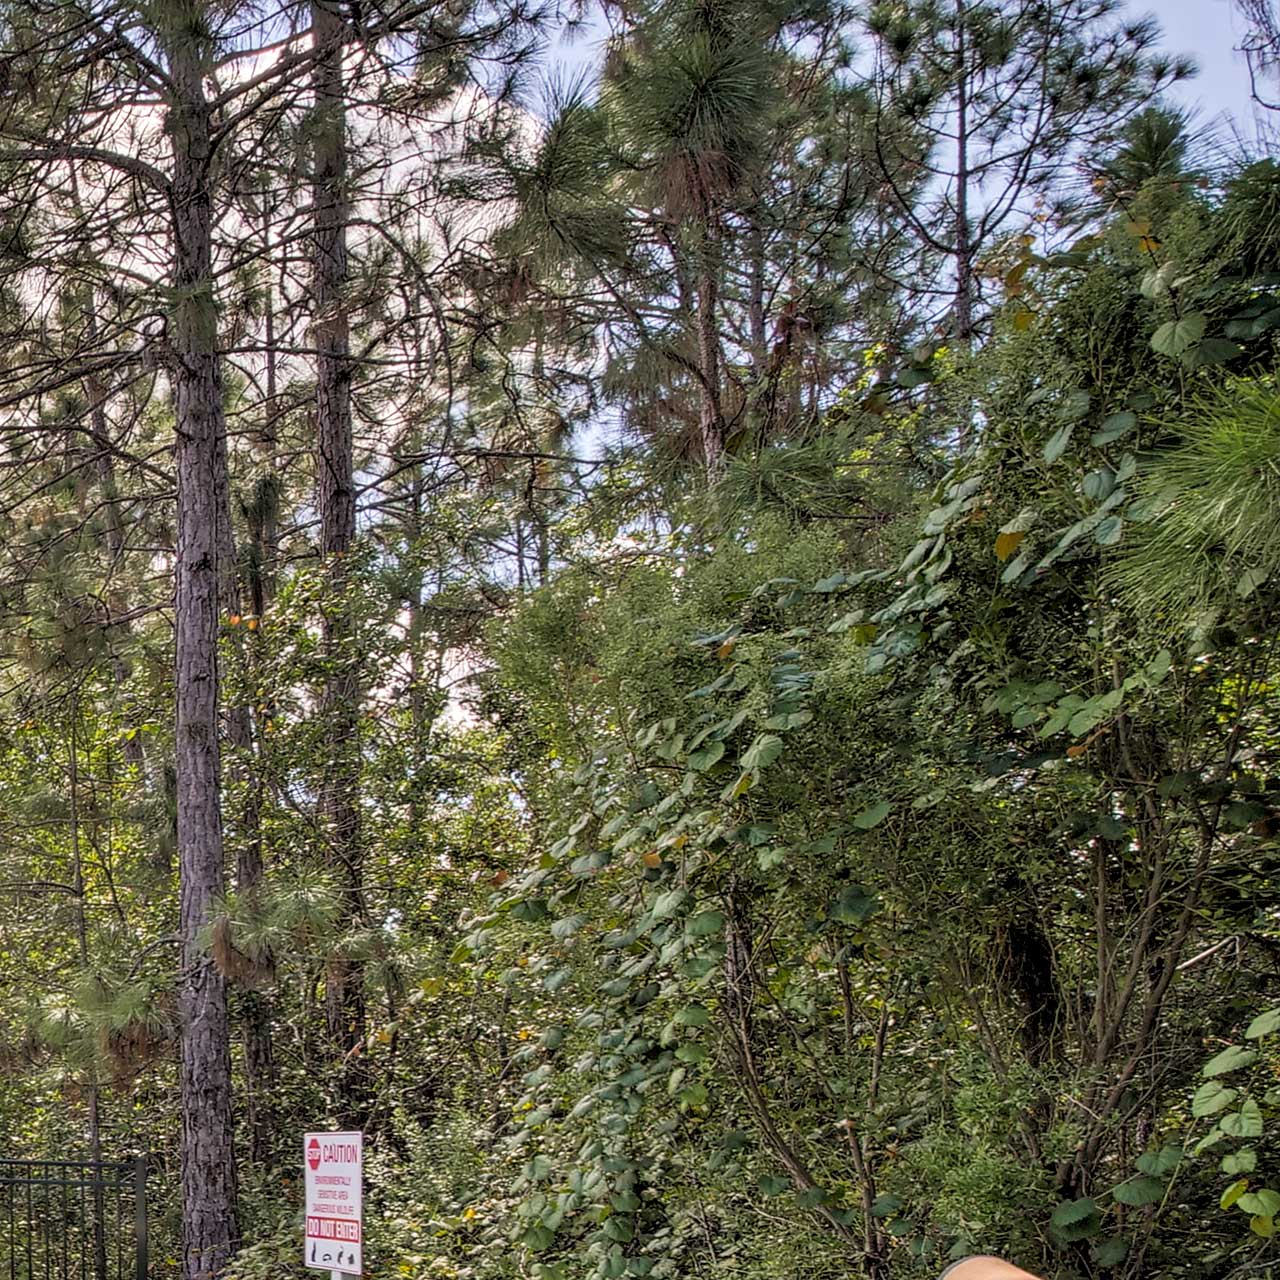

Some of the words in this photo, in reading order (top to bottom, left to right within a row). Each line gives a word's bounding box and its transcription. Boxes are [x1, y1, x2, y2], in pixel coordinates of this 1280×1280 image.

[307, 1149, 321, 1161] STOP
[323, 1144, 358, 1163] CAUTION
[308, 1218, 320, 1236] DO
[320, 1219, 336, 1238] NOT
[336, 1220, 358, 1241] ENTER
